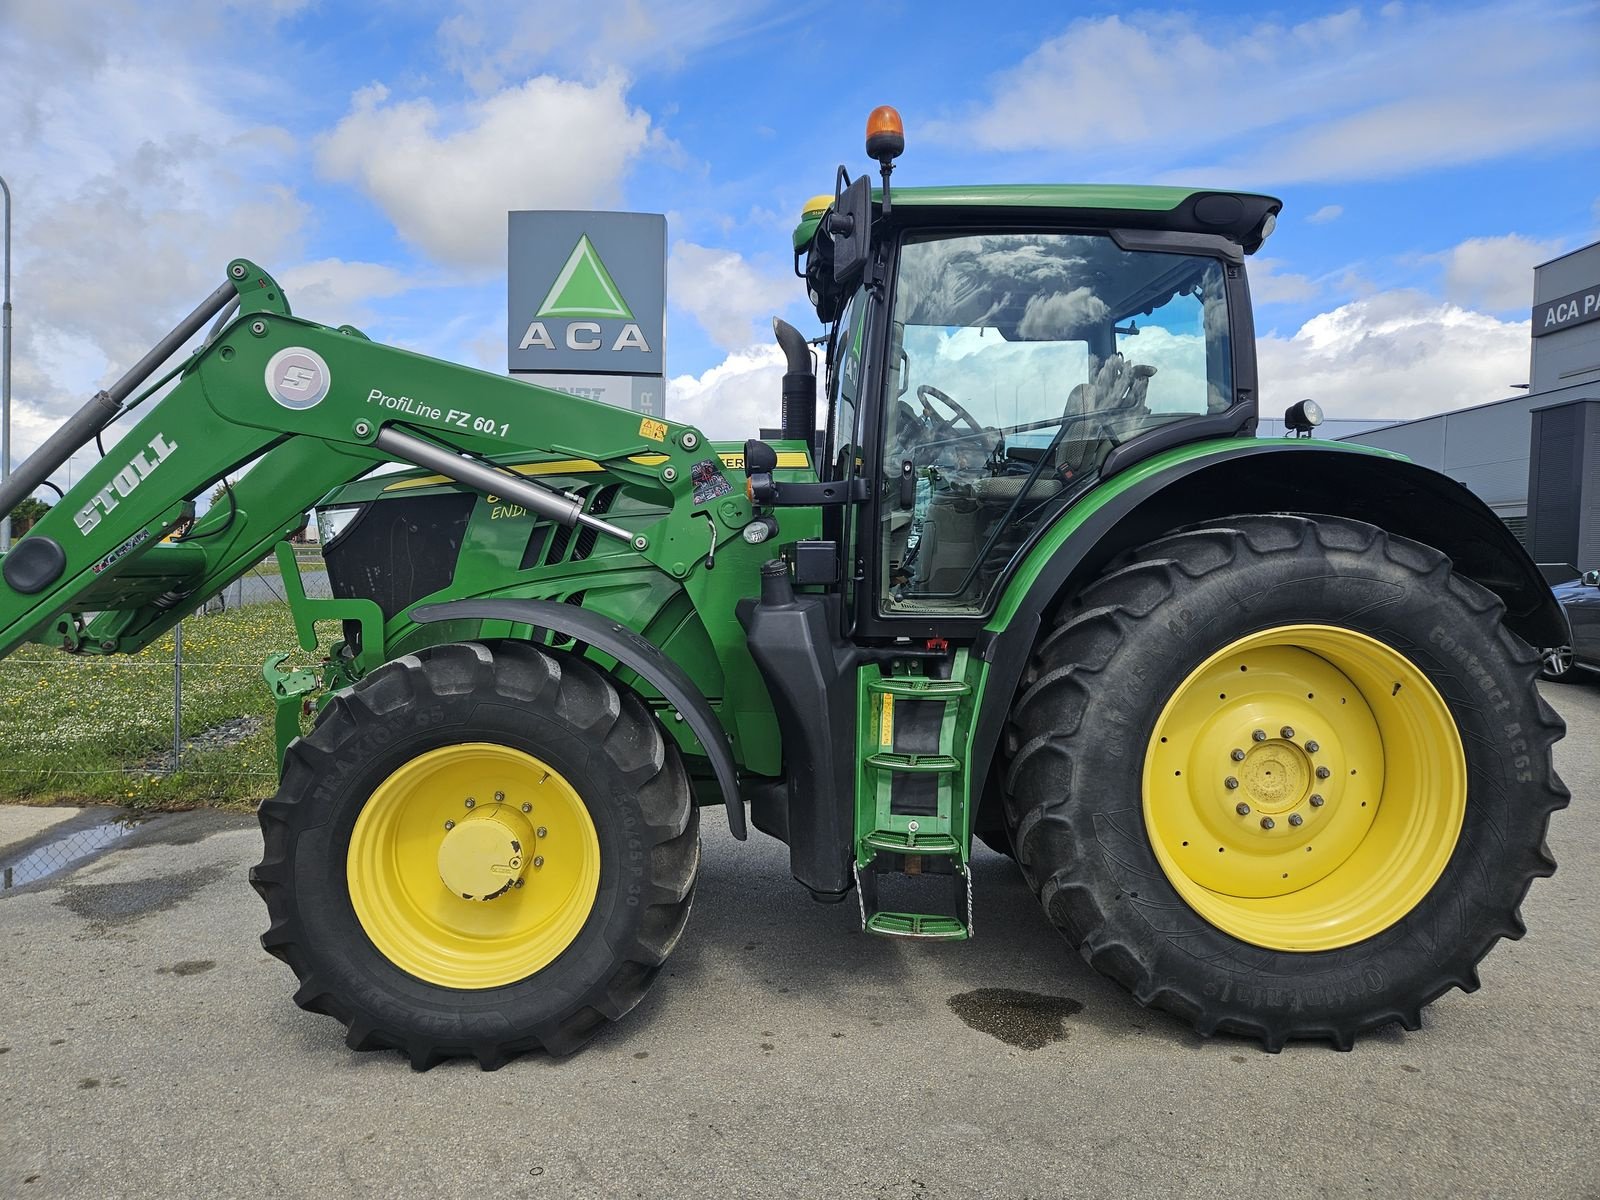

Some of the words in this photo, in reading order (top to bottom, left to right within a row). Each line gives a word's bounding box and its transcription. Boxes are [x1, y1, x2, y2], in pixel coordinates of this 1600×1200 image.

[1544, 300, 1579, 327] ACA
[518, 321, 652, 352] ACA
[366, 389, 442, 420] ProfiLine
[444, 409, 472, 428] FZ
[473, 417, 510, 437] 60.1
[73, 432, 178, 537] STOLL
[626, 883, 641, 907] 30
